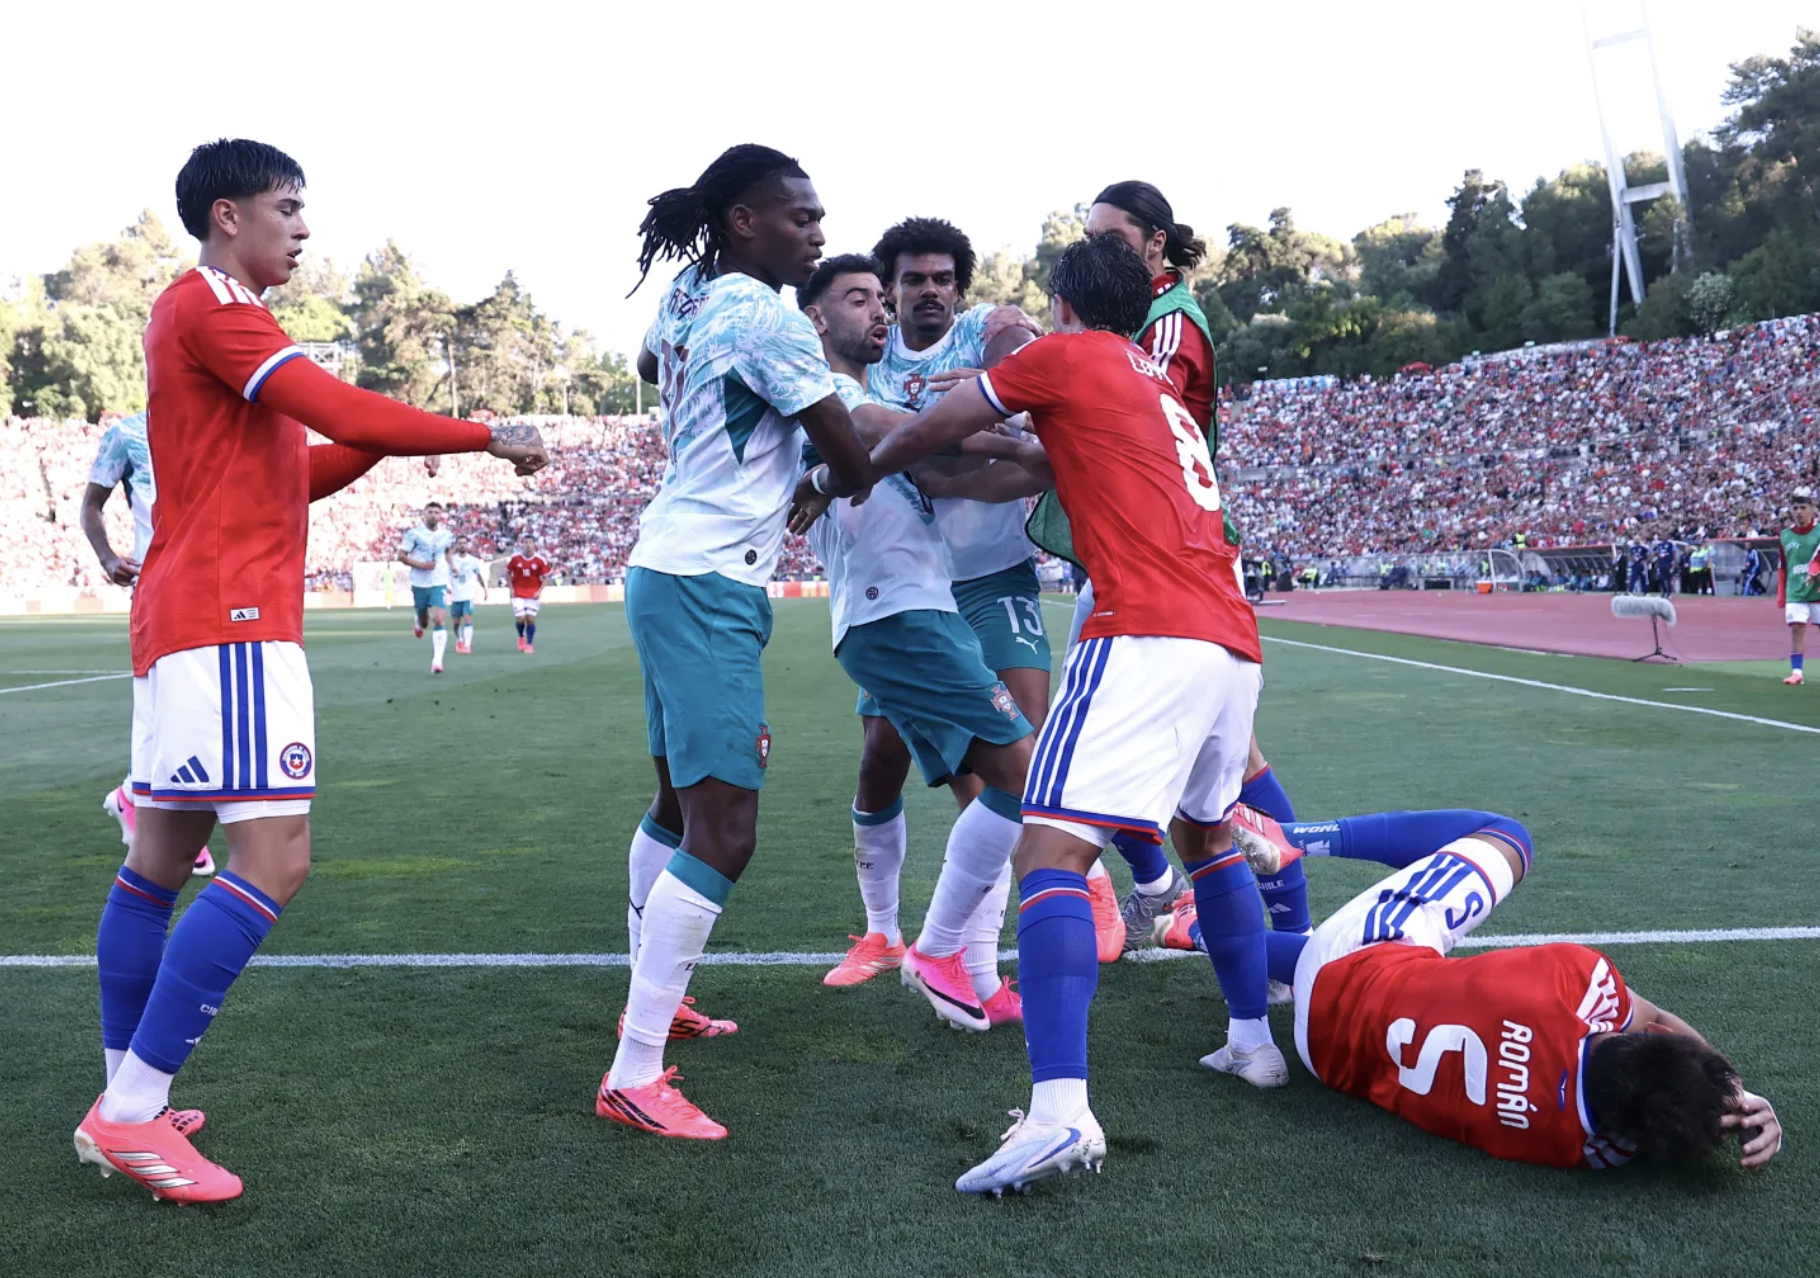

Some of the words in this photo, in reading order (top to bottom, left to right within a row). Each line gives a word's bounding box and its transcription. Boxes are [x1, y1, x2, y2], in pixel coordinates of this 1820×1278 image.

[1160, 394, 1220, 512] 8
[997, 595, 1044, 637] 13
[1445, 891, 1484, 931] 5
[1386, 1017, 1488, 1107] 5
[1496, 1019, 1538, 1130] ROMÁN
